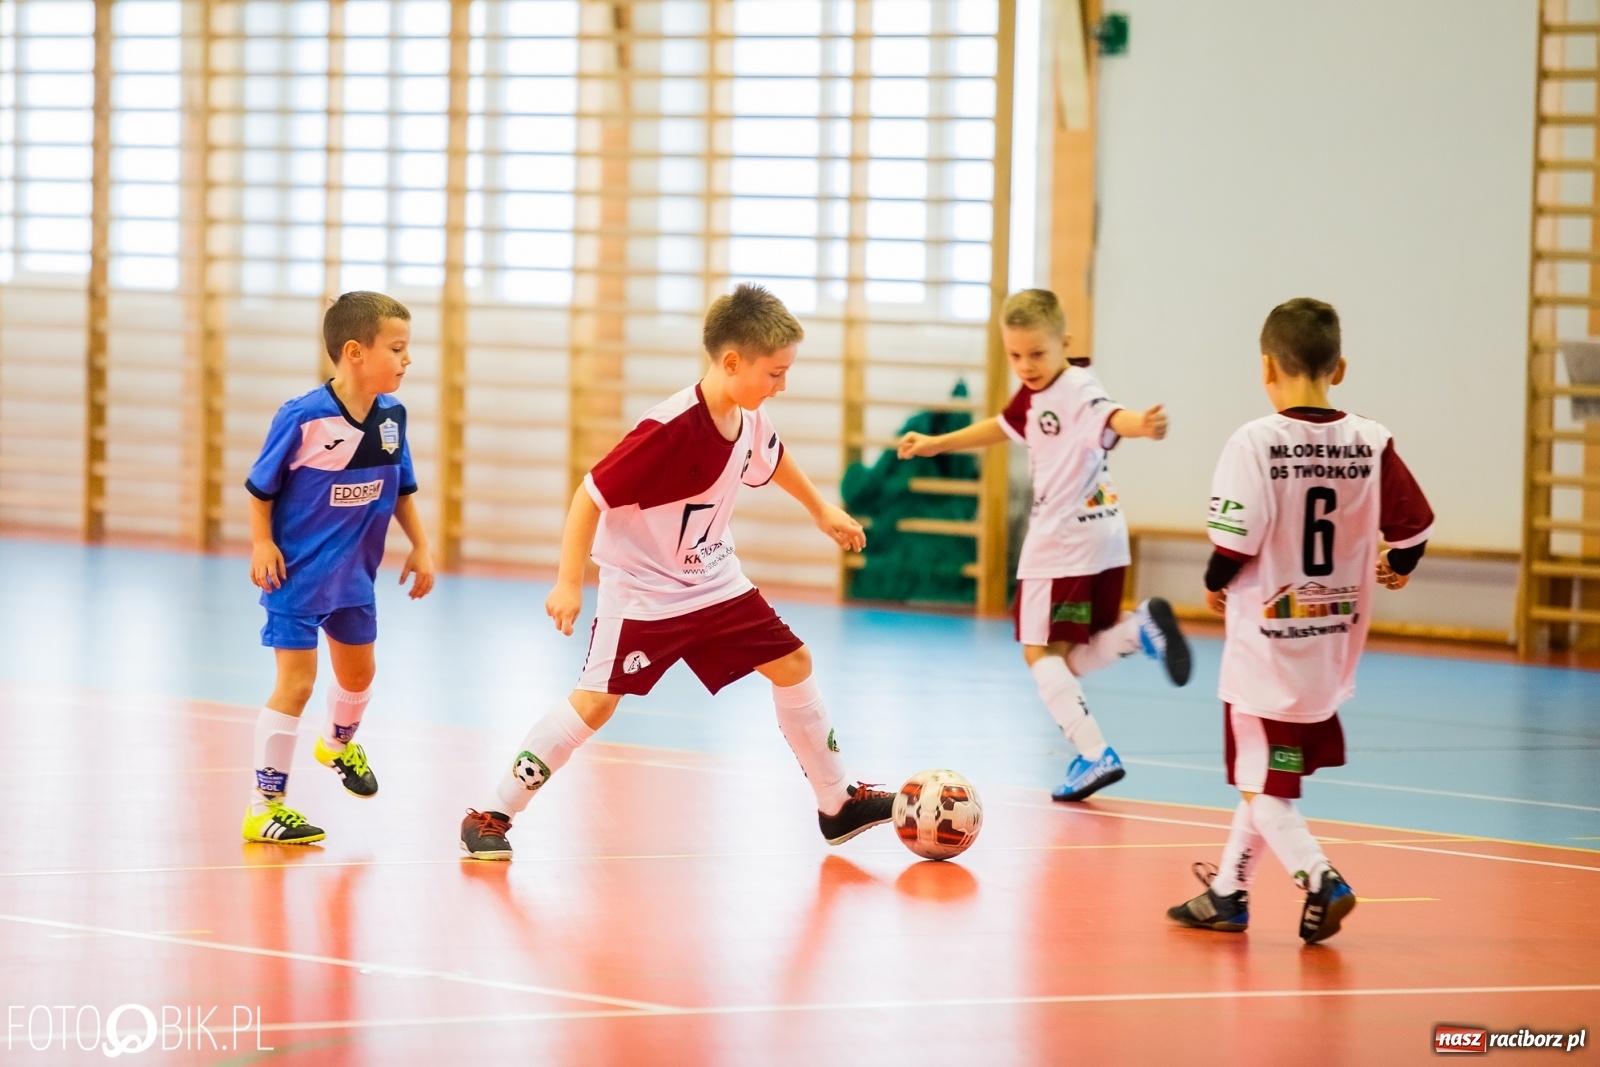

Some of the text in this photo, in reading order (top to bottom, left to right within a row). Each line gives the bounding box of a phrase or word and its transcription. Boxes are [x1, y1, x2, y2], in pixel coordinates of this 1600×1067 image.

[1270, 461, 1374, 480] 05 TWORKÓW
[1303, 486, 1337, 577] 6
